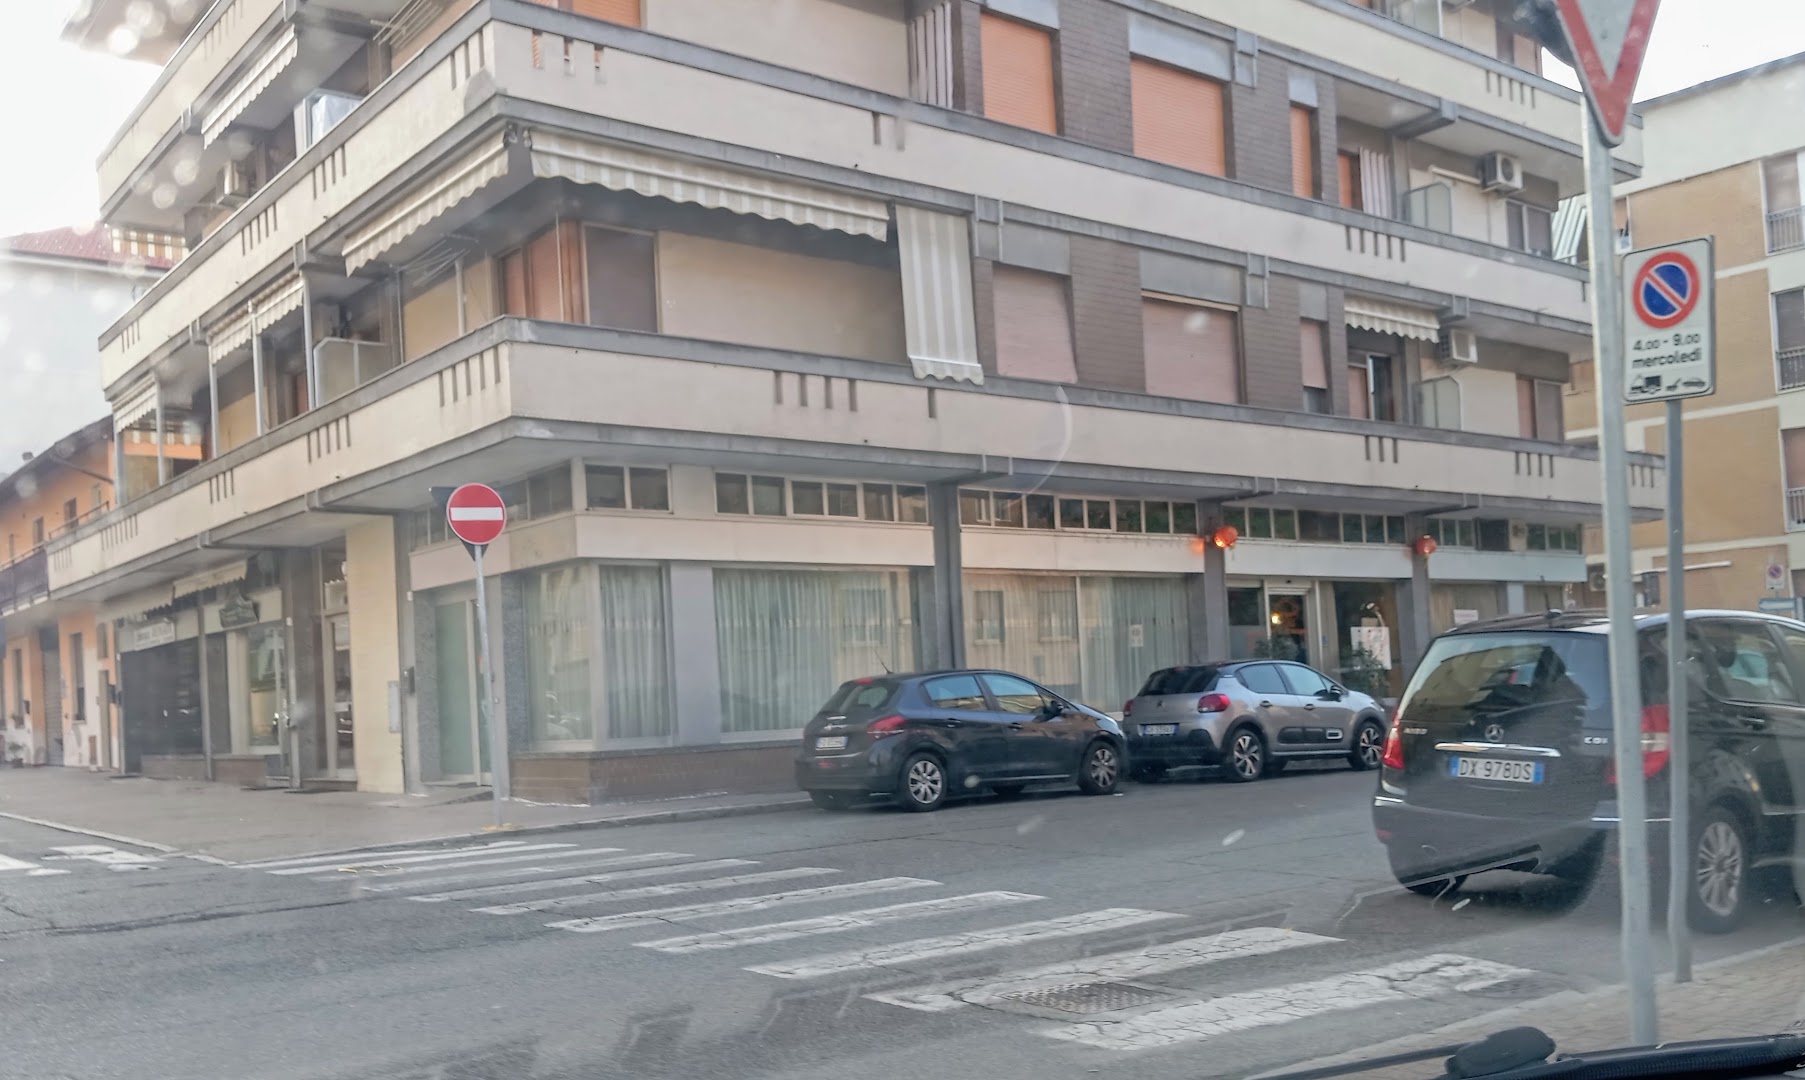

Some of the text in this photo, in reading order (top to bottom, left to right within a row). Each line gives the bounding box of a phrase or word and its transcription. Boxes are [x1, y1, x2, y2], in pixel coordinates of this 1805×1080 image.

[1632, 340, 1660, 350] 4.00
[1673, 333, 1700, 346] 9.00
[1460, 759, 1532, 780] DX 978DS
